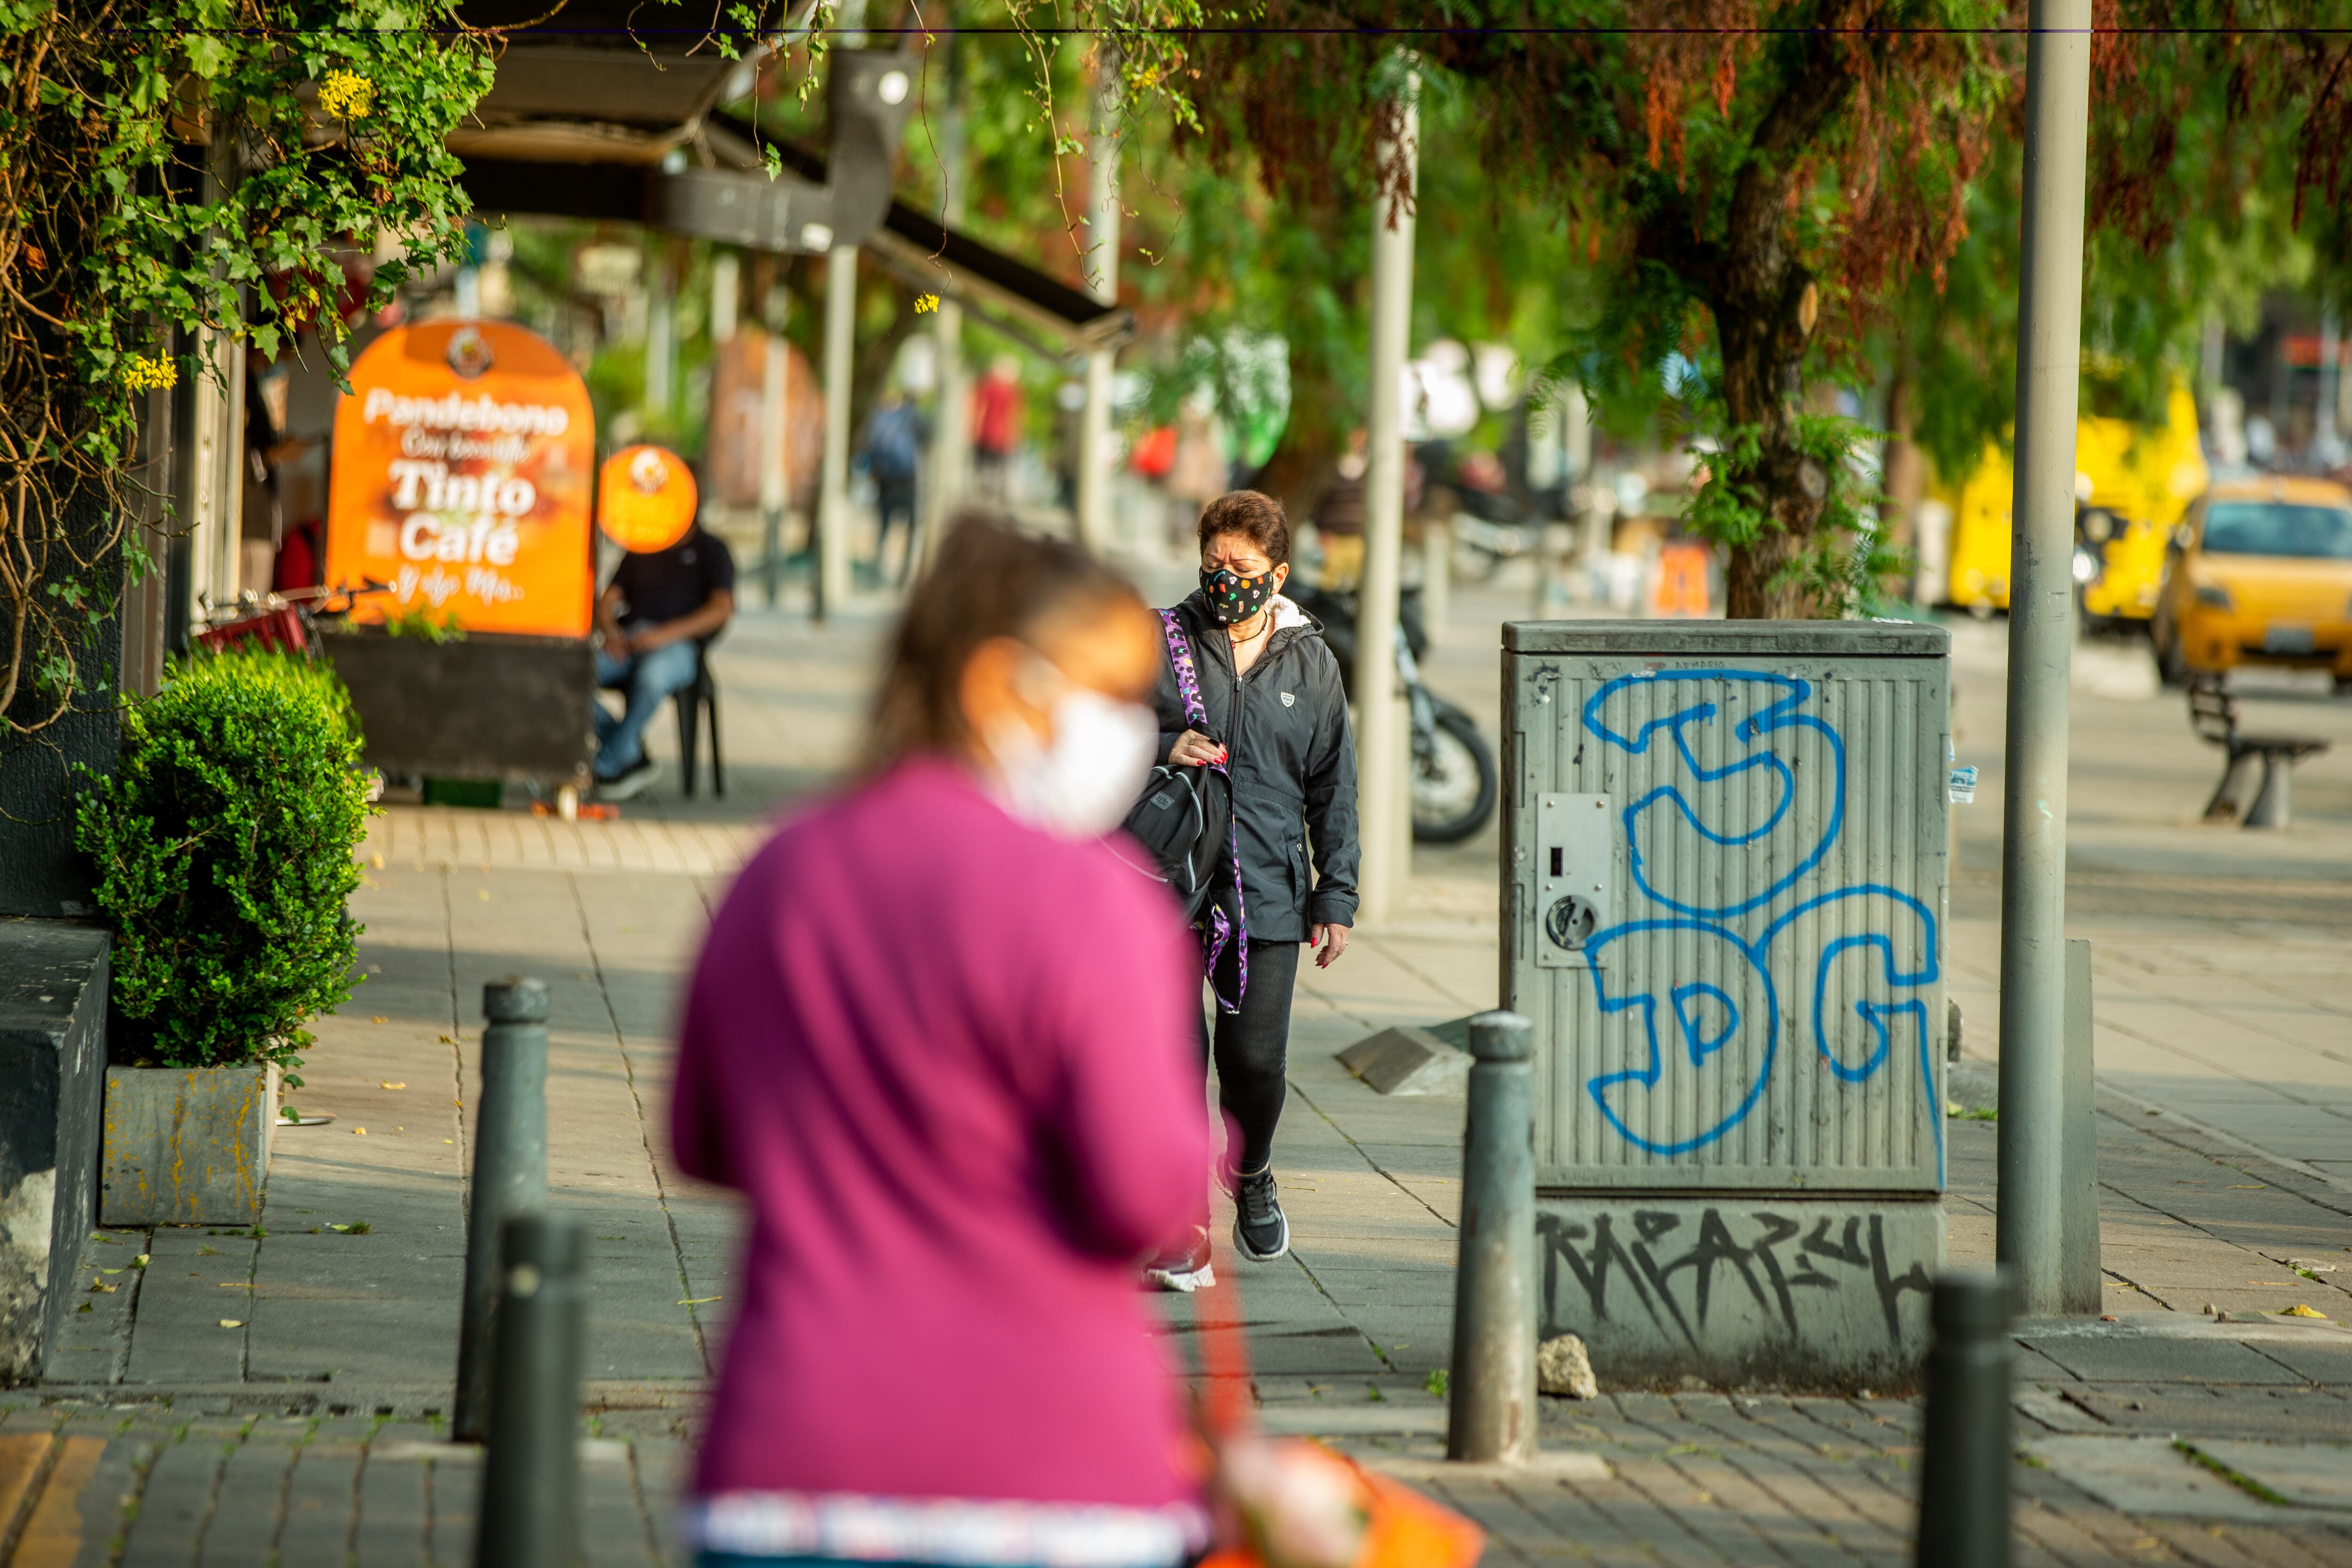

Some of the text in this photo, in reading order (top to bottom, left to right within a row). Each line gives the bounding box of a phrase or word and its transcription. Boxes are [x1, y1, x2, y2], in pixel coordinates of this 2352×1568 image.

[363, 388, 568, 437] Pandebono
[388, 458, 536, 517] Tinto
[400, 512, 519, 566] Café
